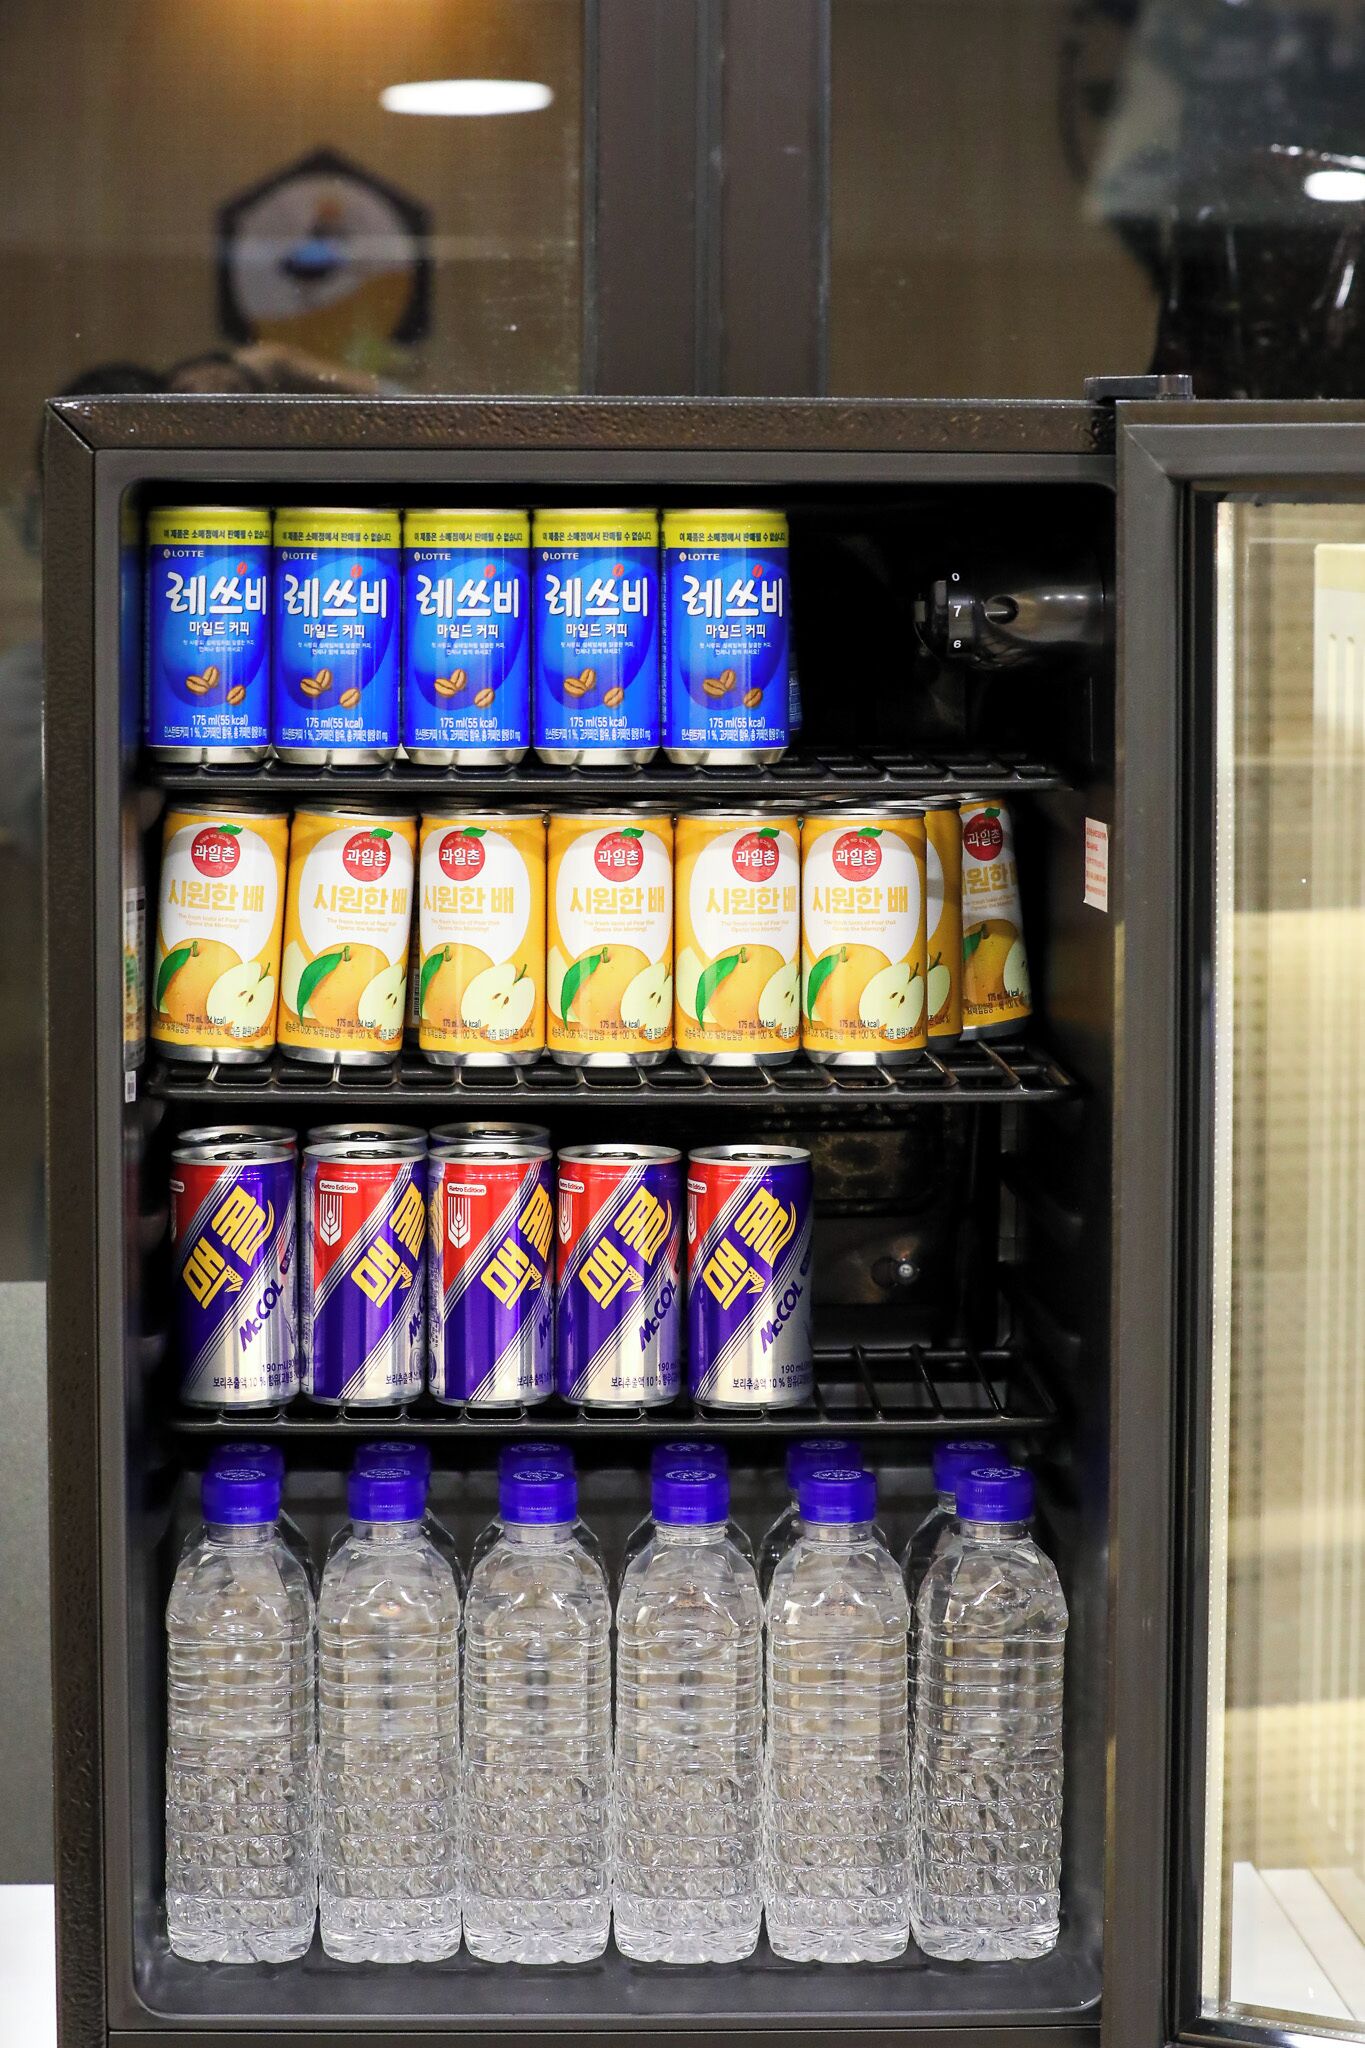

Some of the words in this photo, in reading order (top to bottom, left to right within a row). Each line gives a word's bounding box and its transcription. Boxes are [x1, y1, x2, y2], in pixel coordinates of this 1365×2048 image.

[172, 550, 205, 558] LOTTE
[421, 553, 452, 561] LOTTE
[550, 552, 580, 560] LOTTE
[688, 553, 721, 561] LOTTE
[951, 572, 961, 581] 0
[165, 571, 268, 616] 레쓰비
[284, 573, 388, 619] 레쓰비
[416, 574, 519, 619] 레쓰비
[545, 573, 649, 618] 레쓰비
[682, 574, 784, 619] 레쓰비
[953, 605, 962, 618] 7
[189, 621, 226, 636] 마일드
[229, 621, 250, 636] 커피
[303, 624, 340, 639] 마일드
[342, 624, 365, 639] 커피
[437, 624, 474, 639] 마일드
[476, 624, 499, 639] 커피
[566, 623, 603, 639] 마일드
[605, 623, 629, 638] 커피
[706, 624, 743, 639] 마일드
[746, 624, 767, 639] 커피
[953, 639, 962, 649] 6
[192, 714, 207, 725] 175
[231, 714, 249, 727] kcal)
[305, 717, 320, 728] 175
[345, 717, 364, 730] kcal)
[440, 717, 455, 728] 175
[479, 717, 499, 730] kcal)
[570, 716, 585, 728] 175
[609, 716, 628, 729] kcal)
[709, 717, 724, 728] 175
[749, 717, 767, 729] kcal)
[193, 844, 237, 864] 과일촌
[346, 849, 388, 868] 과일촌
[441, 847, 482, 867] 과일촌
[598, 849, 640, 867] 과일촌
[736, 849, 777, 867] 과일촌
[835, 848, 877, 867] 과일촌
[168, 879, 239, 912] 시원한
[243, 885, 265, 913] 배
[313, 884, 389, 915] 시원한
[391, 887, 407, 915] 배
[423, 885, 487, 914] 시원한
[491, 886, 514, 914] 배
[570, 887, 645, 915] 시원한
[648, 886, 665, 914] 배
[705, 887, 780, 915] 시원한
[782, 886, 797, 913] 배
[812, 886, 884, 914] 시원한
[887, 886, 909, 913] 배
[840, 1019, 849, 1029] 175
[320, 1183, 336, 1191] Retro
[336, 1184, 357, 1193] Edition
[449, 1185, 463, 1193] Retro
[464, 1187, 486, 1195] Edition
[658, 1362, 670, 1372] 190
[781, 1364, 795, 1374] 190
[213, 1377, 247, 1389] 보리추출액
[611, 1376, 645, 1389] 보리추출액
[647, 1377, 654, 1387] 10
[732, 1378, 768, 1390] 보리추출액
[769, 1378, 777, 1388] 10
[779, 1377, 786, 1389] %
